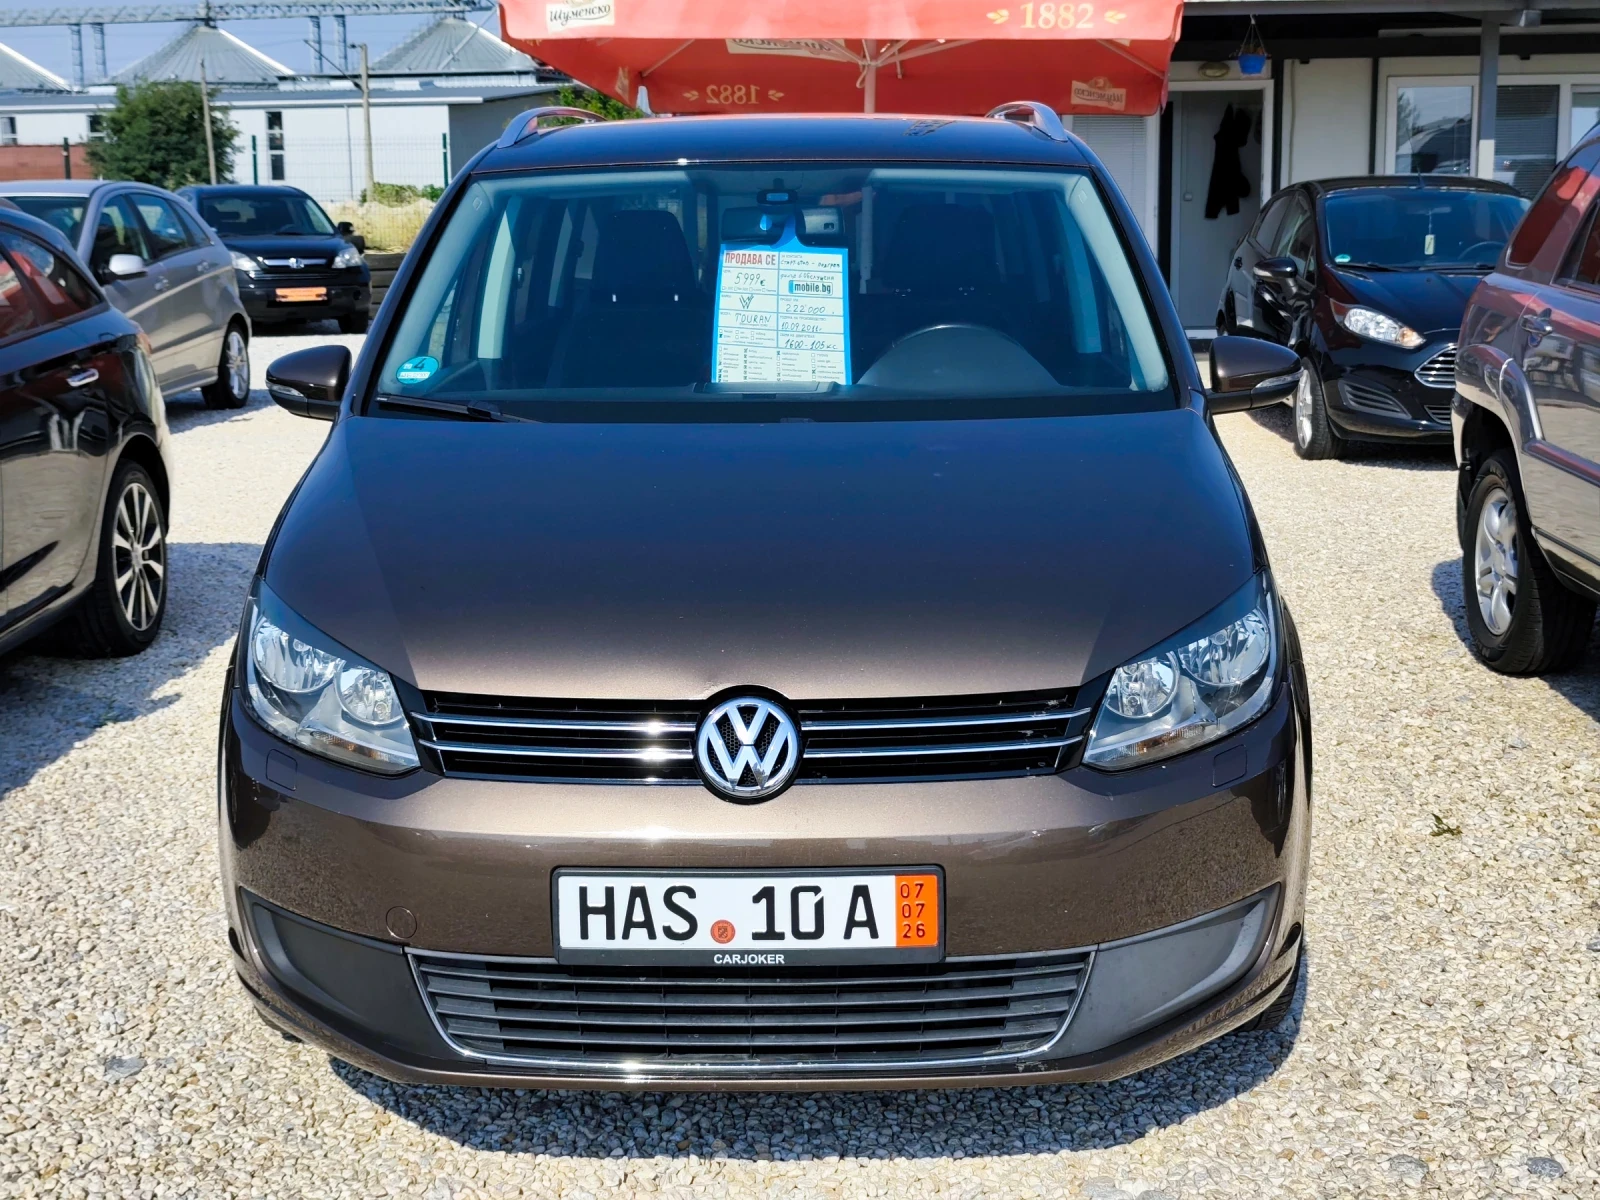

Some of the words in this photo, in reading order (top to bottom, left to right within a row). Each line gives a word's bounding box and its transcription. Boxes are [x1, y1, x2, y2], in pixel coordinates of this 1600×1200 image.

[549, 4, 611, 26] Шуменско
[1019, 2, 1095, 29] 1882
[724, 252, 763, 266] ПРОДАВА
[765, 254, 777, 266] СЕ
[794, 282, 831, 294] mobile.bg
[735, 312, 772, 324] TOURAN
[413, 358, 426, 370] 4
[703, 699, 794, 794] VW
[900, 883, 925, 899] 07
[578, 884, 699, 941] HAS
[901, 902, 925, 919] 07
[902, 923, 926, 939] 26
[713, 953, 786, 965] CARJOKER
